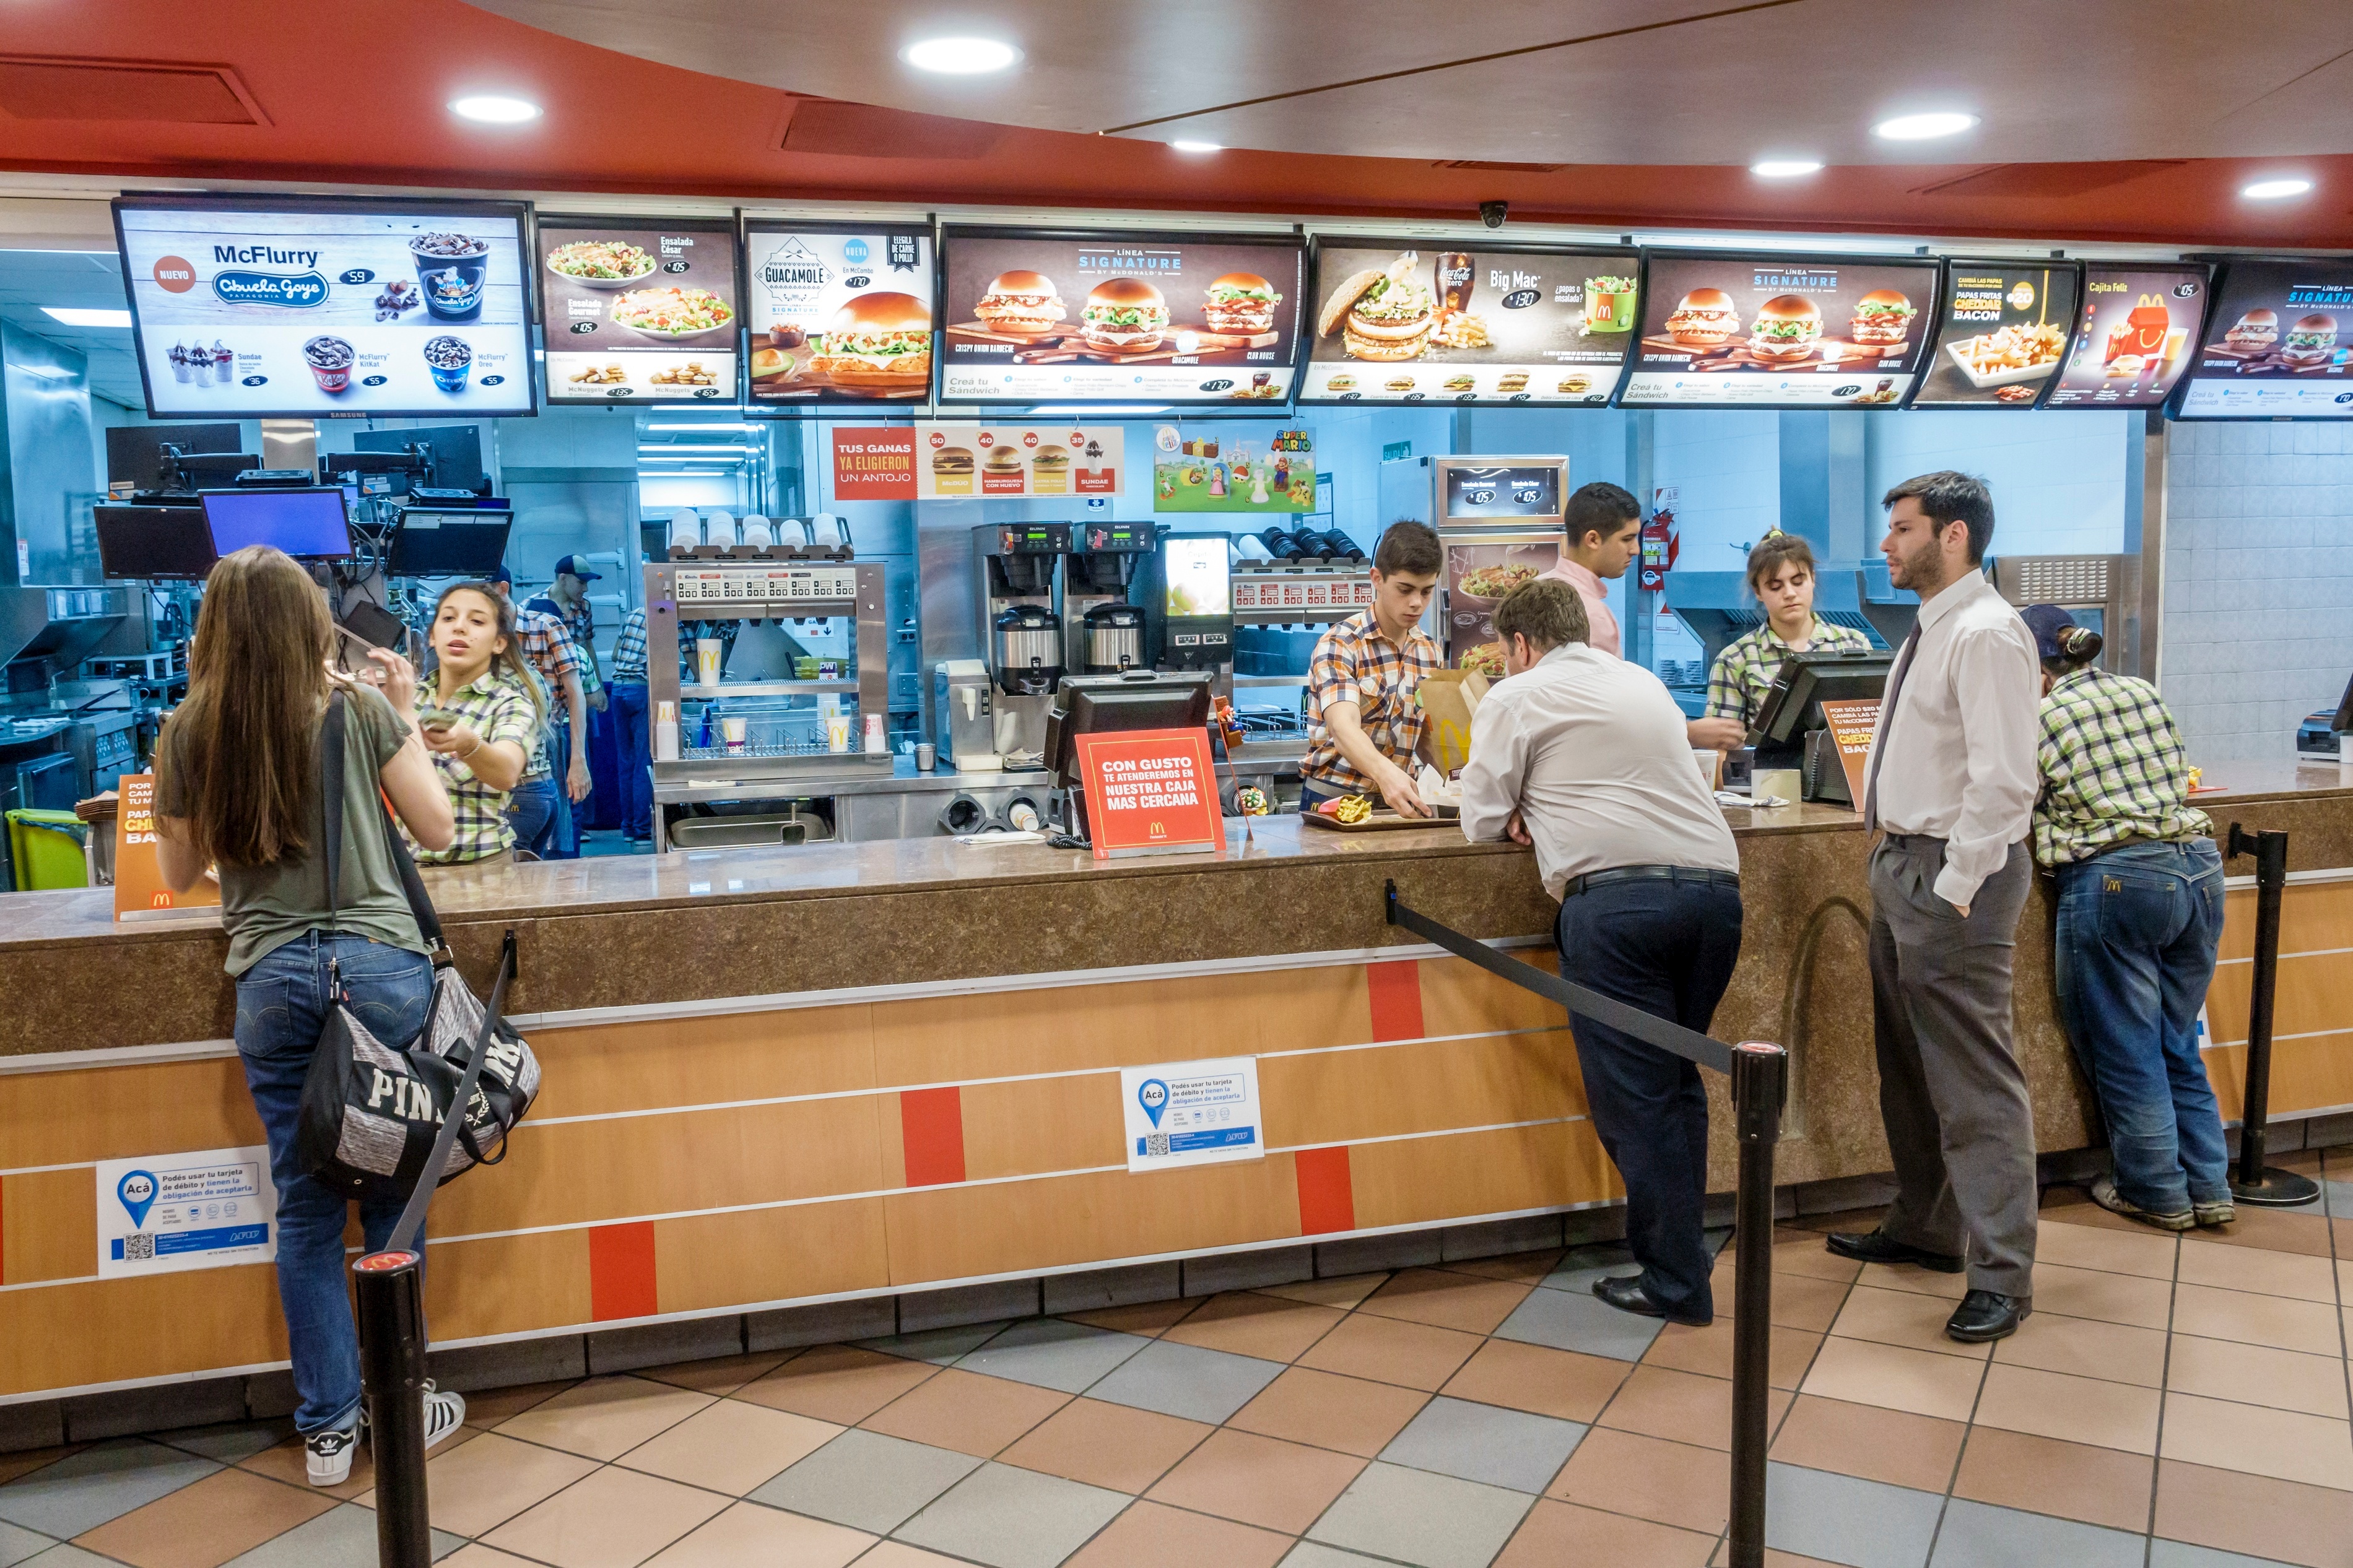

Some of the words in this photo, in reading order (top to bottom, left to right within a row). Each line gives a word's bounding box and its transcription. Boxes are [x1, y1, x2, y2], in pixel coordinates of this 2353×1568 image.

[660, 236, 694, 246] Ensalada
[661, 245, 682, 254] César
[845, 248, 867, 256] NUEVA
[892, 244, 898, 253] DE
[898, 245, 915, 253] CARNE
[214, 245, 318, 267] McFlurry
[894, 253, 897, 262] O
[898, 253, 913, 262] POLLO
[1079, 256, 1181, 269] SIGNATURE
[159, 270, 189, 280] NUEVO
[765, 267, 824, 284] GUACAMOLE
[1440, 267, 1472, 280] Coca-Cola
[1490, 270, 1510, 292] Big
[1513, 271, 1538, 288] Mac
[1754, 275, 1837, 287] SIGNATURE
[281, 279, 320, 299] Goye
[1555, 285, 1575, 295] ¿papas
[2089, 282, 2112, 294] Cajita
[2112, 283, 2128, 292] Feliz
[1554, 293, 1583, 303] ensalada?
[2288, 292, 2353, 303] SIGNATU
[567, 299, 602, 308] Ensalada
[1954, 299, 2002, 310] CHEDDAR
[568, 307, 601, 316] Gourmet
[1954, 310, 2001, 321] BACON
[955, 344, 973, 353] CRISPY
[973, 344, 989, 353] ONION
[989, 344, 1014, 353] BARBECUE
[1172, 356, 1199, 364] GUACAMOLE
[1247, 352, 1258, 360] CLUB
[1259, 352, 1274, 360] HOUSE
[1889, 360, 1902, 368] HOUSE
[949, 386, 1000, 394] Sándwich
[1626, 391, 1669, 399] Sándwich
[1276, 430, 1307, 440] SUPER
[838, 444, 864, 453] TUS
[866, 444, 911, 453] GANAS
[1271, 438, 1311, 453] MARIO
[1384, 450, 1401, 461] SALIDA
[840, 457, 853, 470] YA
[856, 456, 910, 470] ELIGIERON
[840, 474, 859, 482] UN
[863, 473, 911, 482] ANTOJO
[1838, 734, 1872, 745] CHEDD
[1102, 760, 1136, 772] CON
[1140, 756, 1192, 770] GUSTO
[1104, 774, 1115, 782] TE
[1117, 771, 1181, 781] ATENDEREMOS
[1183, 769, 1194, 778] EN
[1105, 782, 1162, 796] NUESTRA
[1166, 780, 1196, 792] CAJA
[1107, 795, 1137, 810] MAS
[1141, 792, 1199, 808] CERCANA
[368, 1068, 445, 1124] PIN
[1146, 1089, 1163, 1099] Acá
[1173, 1096, 1203, 1104] obligación
[1213, 1093, 1240, 1101] aceptarla
[217, 1169, 243, 1177] tarjeta
[126, 1182, 150, 1195] Acá
[174, 1181, 198, 1190] débito
[207, 1179, 230, 1187] tienen
[163, 1190, 202, 1200] obligación
[216, 1185, 253, 1195] aceptarla
